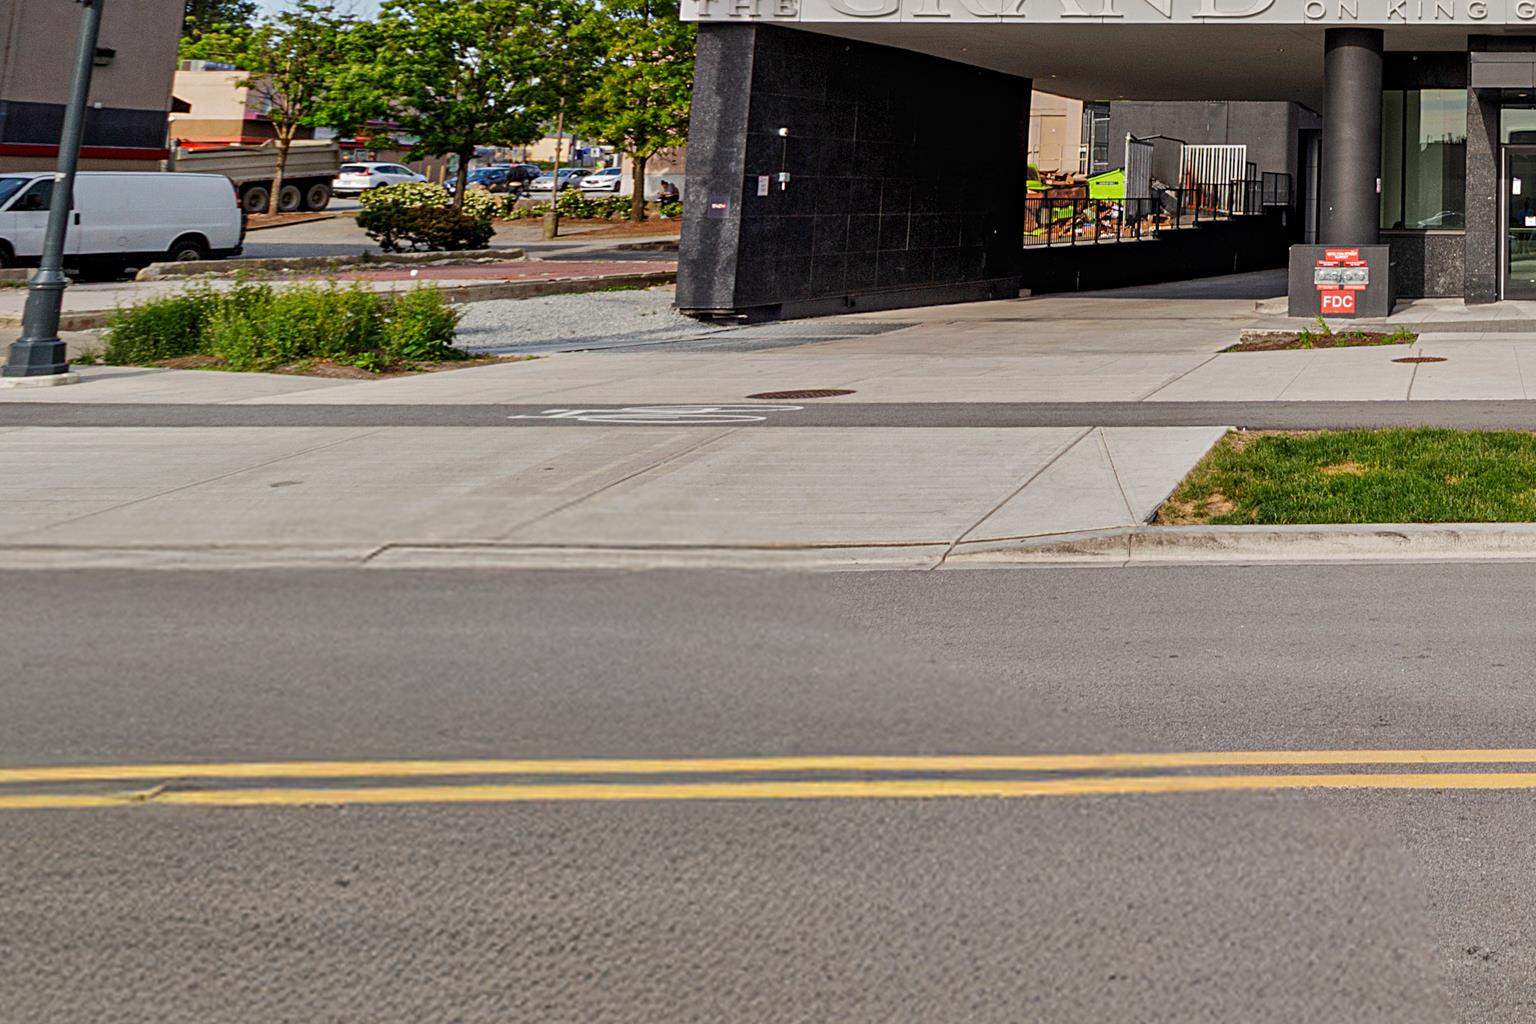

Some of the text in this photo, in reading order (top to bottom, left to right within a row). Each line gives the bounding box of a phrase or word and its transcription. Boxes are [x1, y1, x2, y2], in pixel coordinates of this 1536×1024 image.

[1303, 0, 1359, 20] ON
[1386, 0, 1489, 20] KING
[1323, 295, 1353, 308] FDC
